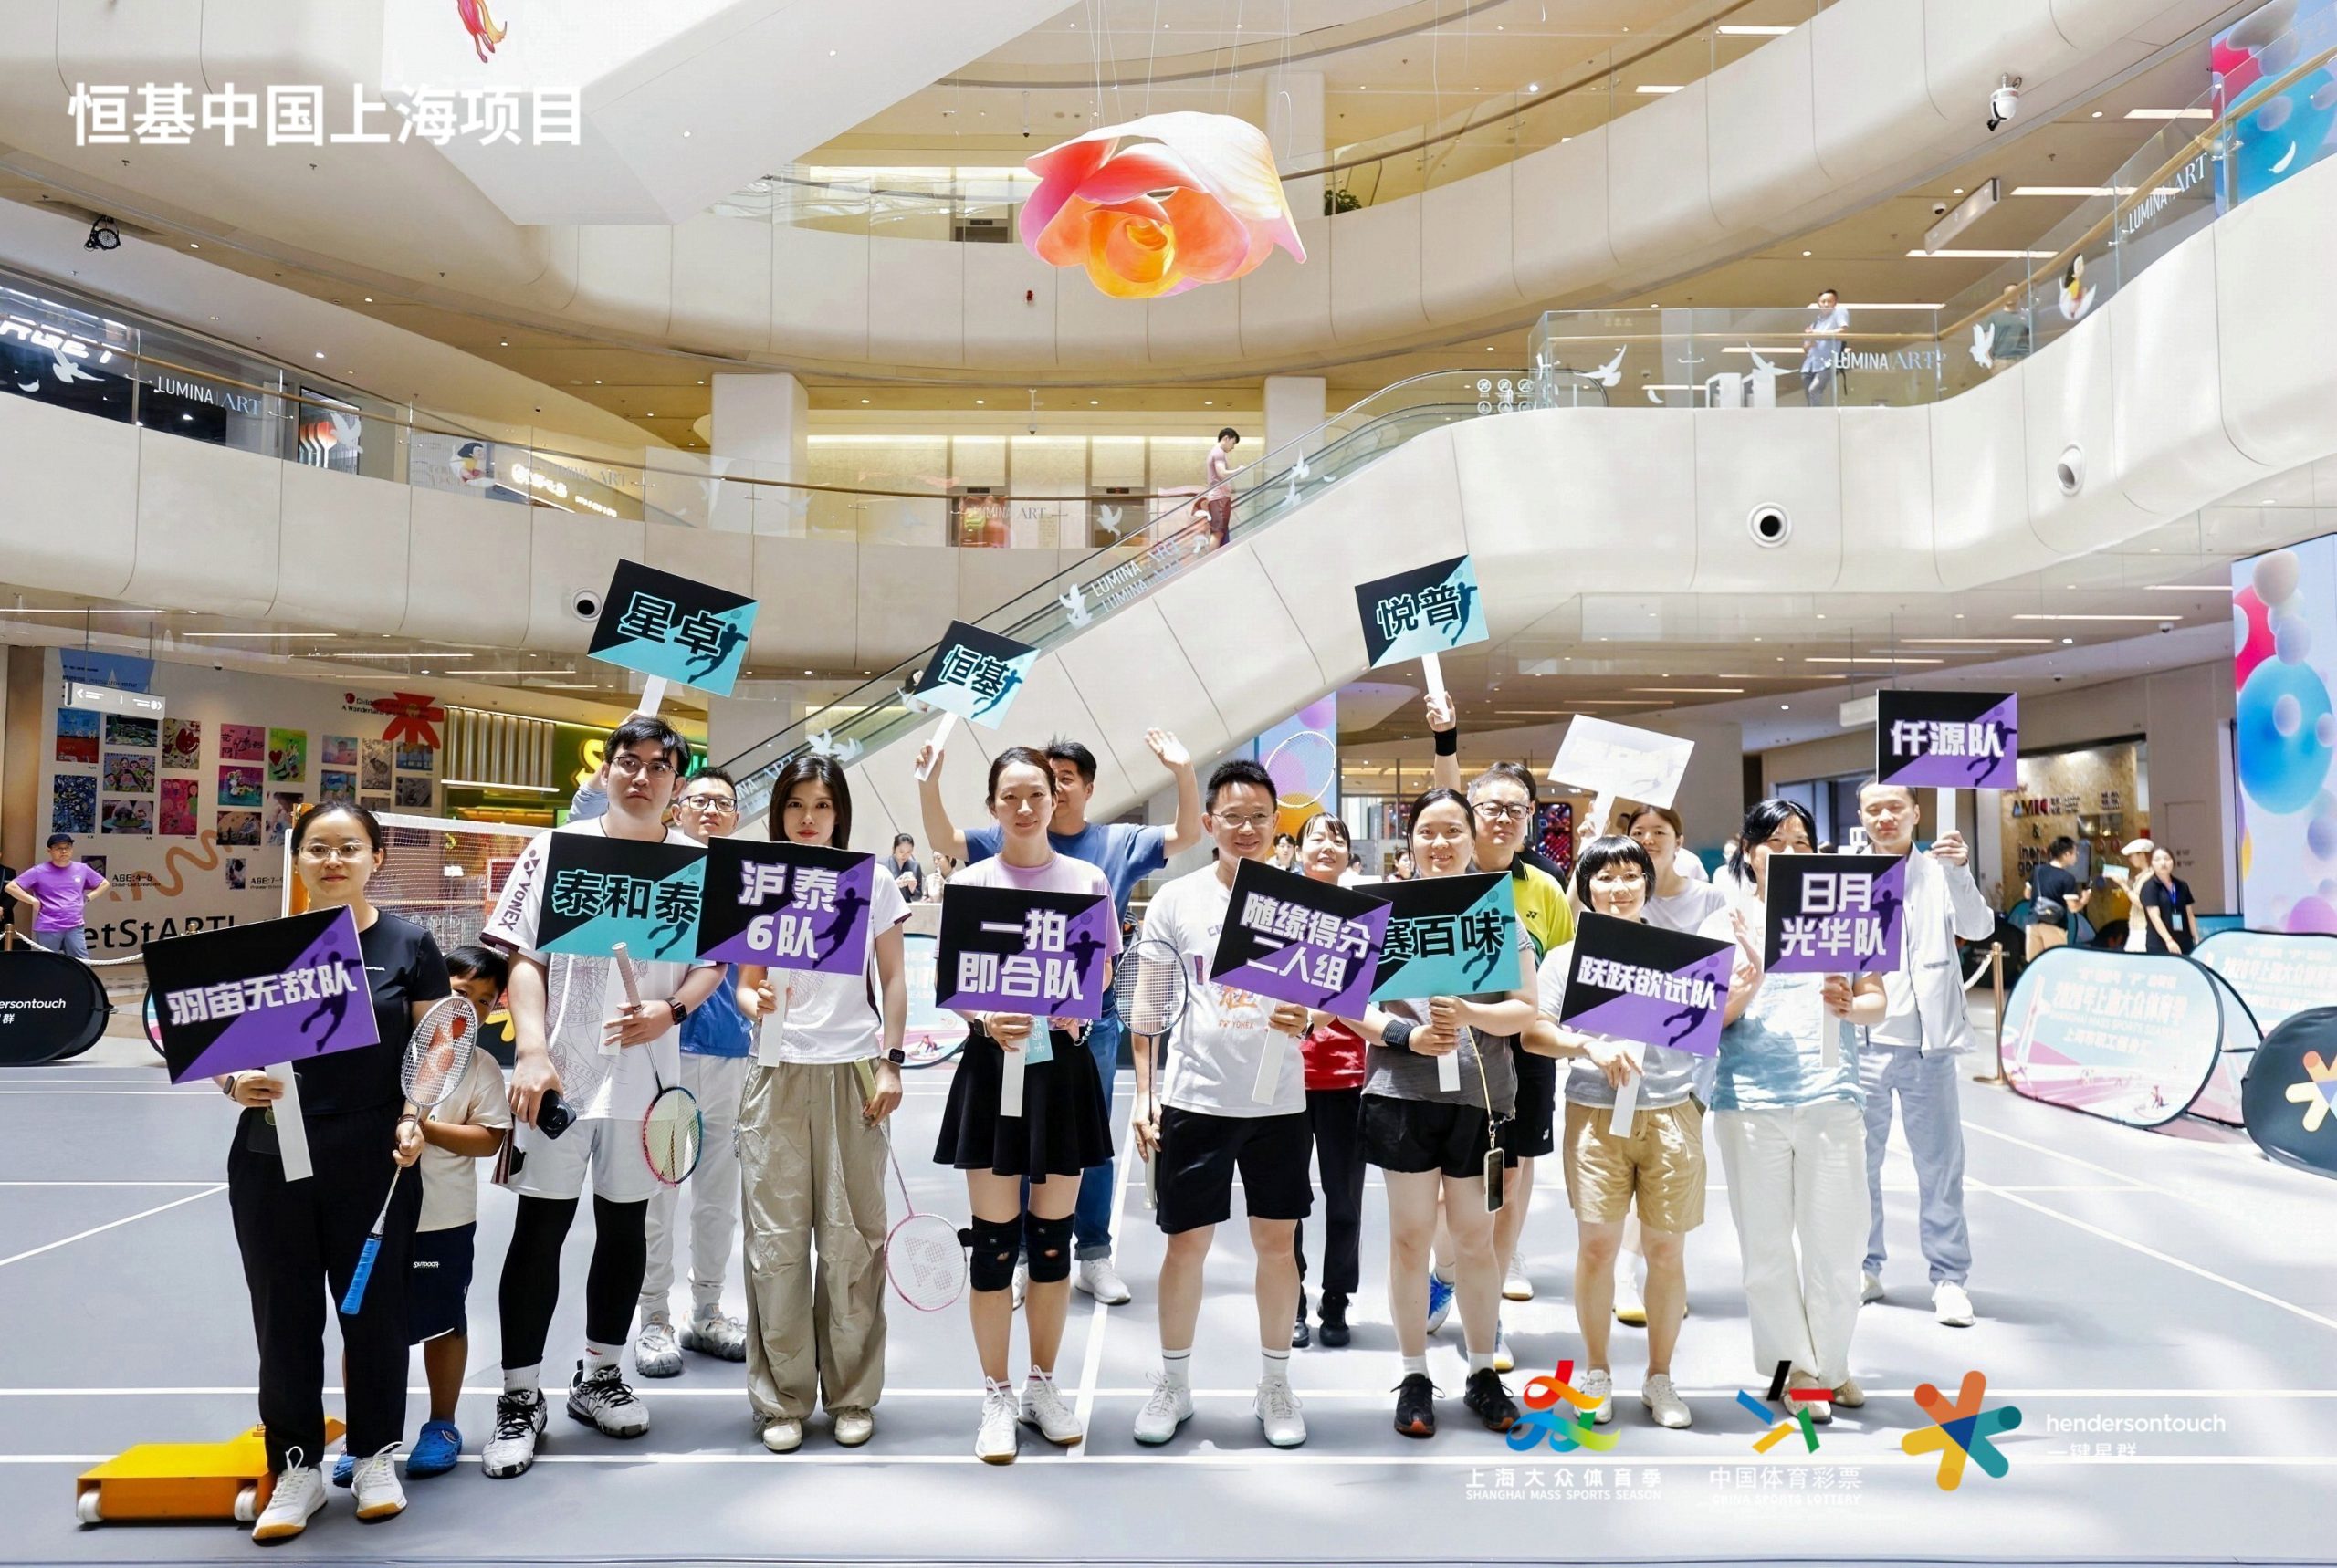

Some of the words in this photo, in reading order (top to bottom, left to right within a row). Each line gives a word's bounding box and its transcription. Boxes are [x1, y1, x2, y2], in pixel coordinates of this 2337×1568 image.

[2129, 185, 2168, 234] LUMINA
[2175, 152, 2207, 193] ART
[1835, 351, 1889, 370] LUMINA
[1893, 350, 1936, 370] ART
[157, 375, 214, 404] LUMINA
[220, 392, 262, 415] ART
[1091, 559, 1143, 598] LUMINA
[617, 591, 727, 657] 星卓
[1376, 583, 1460, 640] 悦普
[938, 644, 1010, 699] 恒基
[1890, 719, 2004, 758] 仟源队
[498, 883, 530, 932] YONEX
[551, 869, 700, 924] 泰和泰
[738, 860, 840, 913] 沪泰
[1801, 873, 1872, 913] 日月
[746, 914, 819, 959] 6队
[980, 908, 1068, 953] 一拍
[1240, 891, 1371, 958] 随缘得分
[1378, 911, 1504, 965] 赛百味
[1780, 915, 1887, 956] 光华队
[957, 951, 1084, 1000] 即合队
[1246, 935, 1348, 993] 二人组
[1576, 955, 1717, 1010] 跃跃欲试队
[165, 961, 357, 1026] 羽宙无敌队
